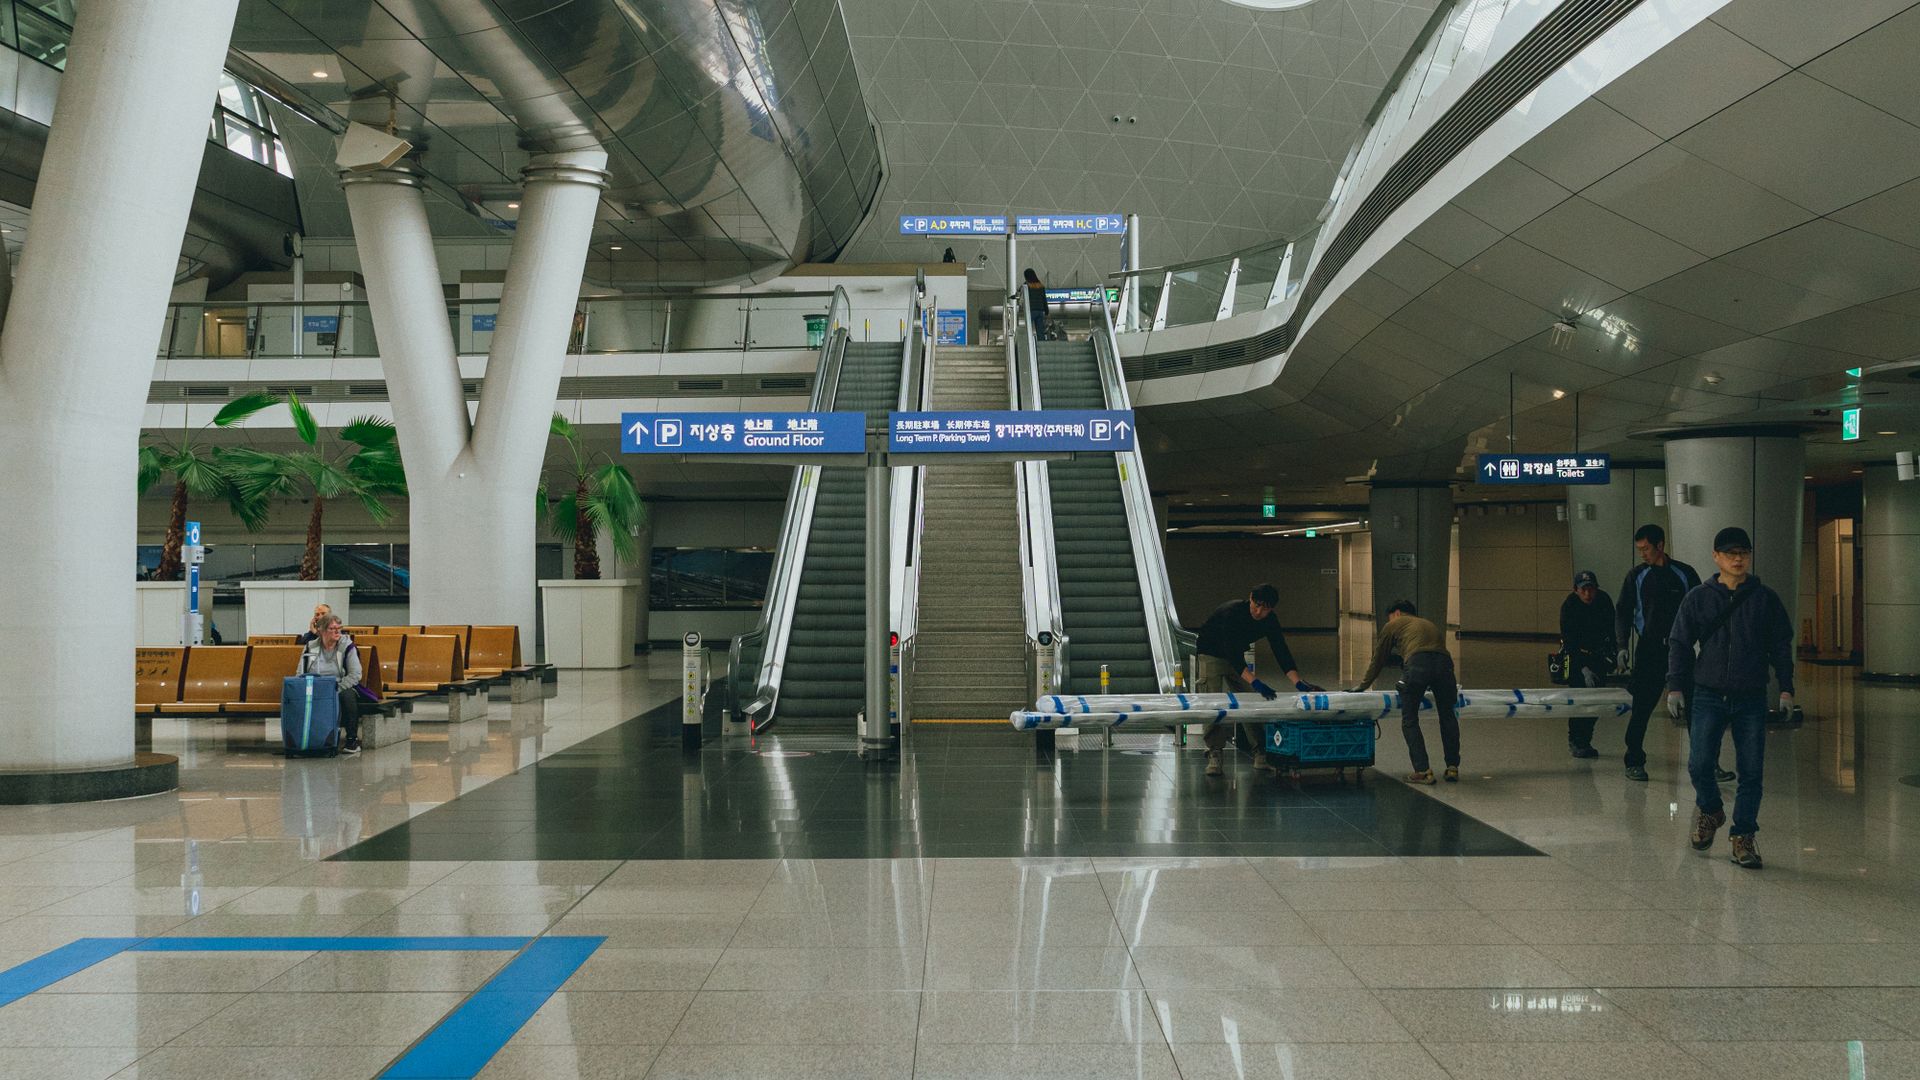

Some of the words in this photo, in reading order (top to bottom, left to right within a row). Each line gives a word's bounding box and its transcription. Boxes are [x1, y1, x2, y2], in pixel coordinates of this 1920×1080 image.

[662, 424, 677, 442] P
[689, 423, 736, 443] 지상층
[1095, 423, 1107, 437] P
[743, 434, 790, 446] Ground
[793, 434, 824, 446] Floor
[896, 434, 914, 444] Long
[914, 434, 932, 442] Term
[932, 434, 938, 442] P.
[938, 433, 966, 444] (Parking
[966, 433, 990, 443] Tower)
[1522, 462, 1554, 475] 화장실
[1556, 470, 1585, 478] Toilets
